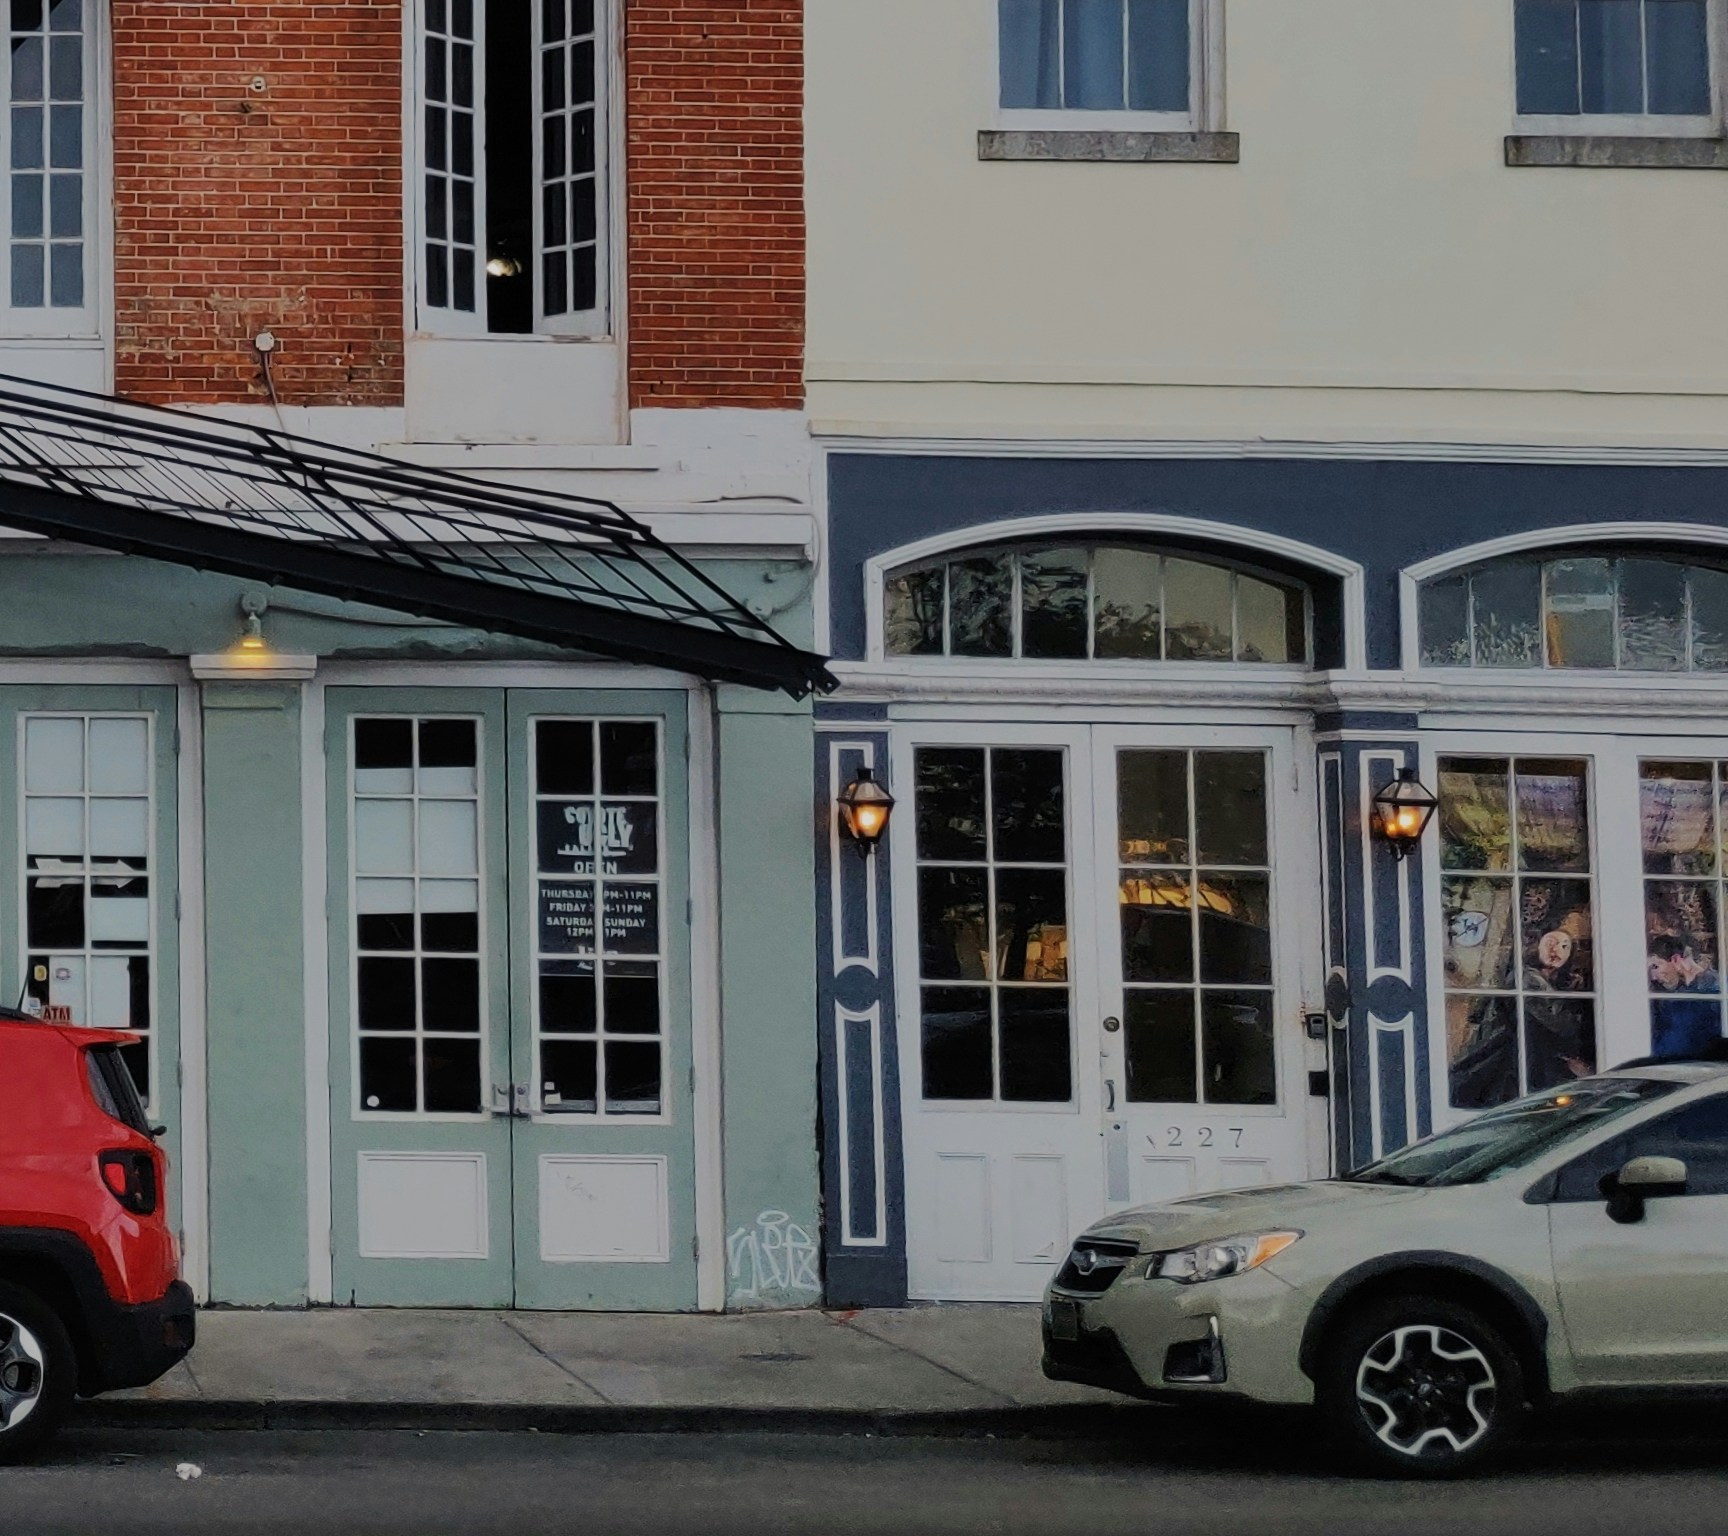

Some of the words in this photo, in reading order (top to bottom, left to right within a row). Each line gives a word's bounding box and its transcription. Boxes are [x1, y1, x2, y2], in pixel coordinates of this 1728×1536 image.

[601, 890, 652, 901] PM-11PM
[549, 902, 586, 912] FRIDAY
[604, 918, 646, 928] SUNDAY
[43, 1008, 71, 1021] ATM
[1166, 1126, 1244, 1148] 227
